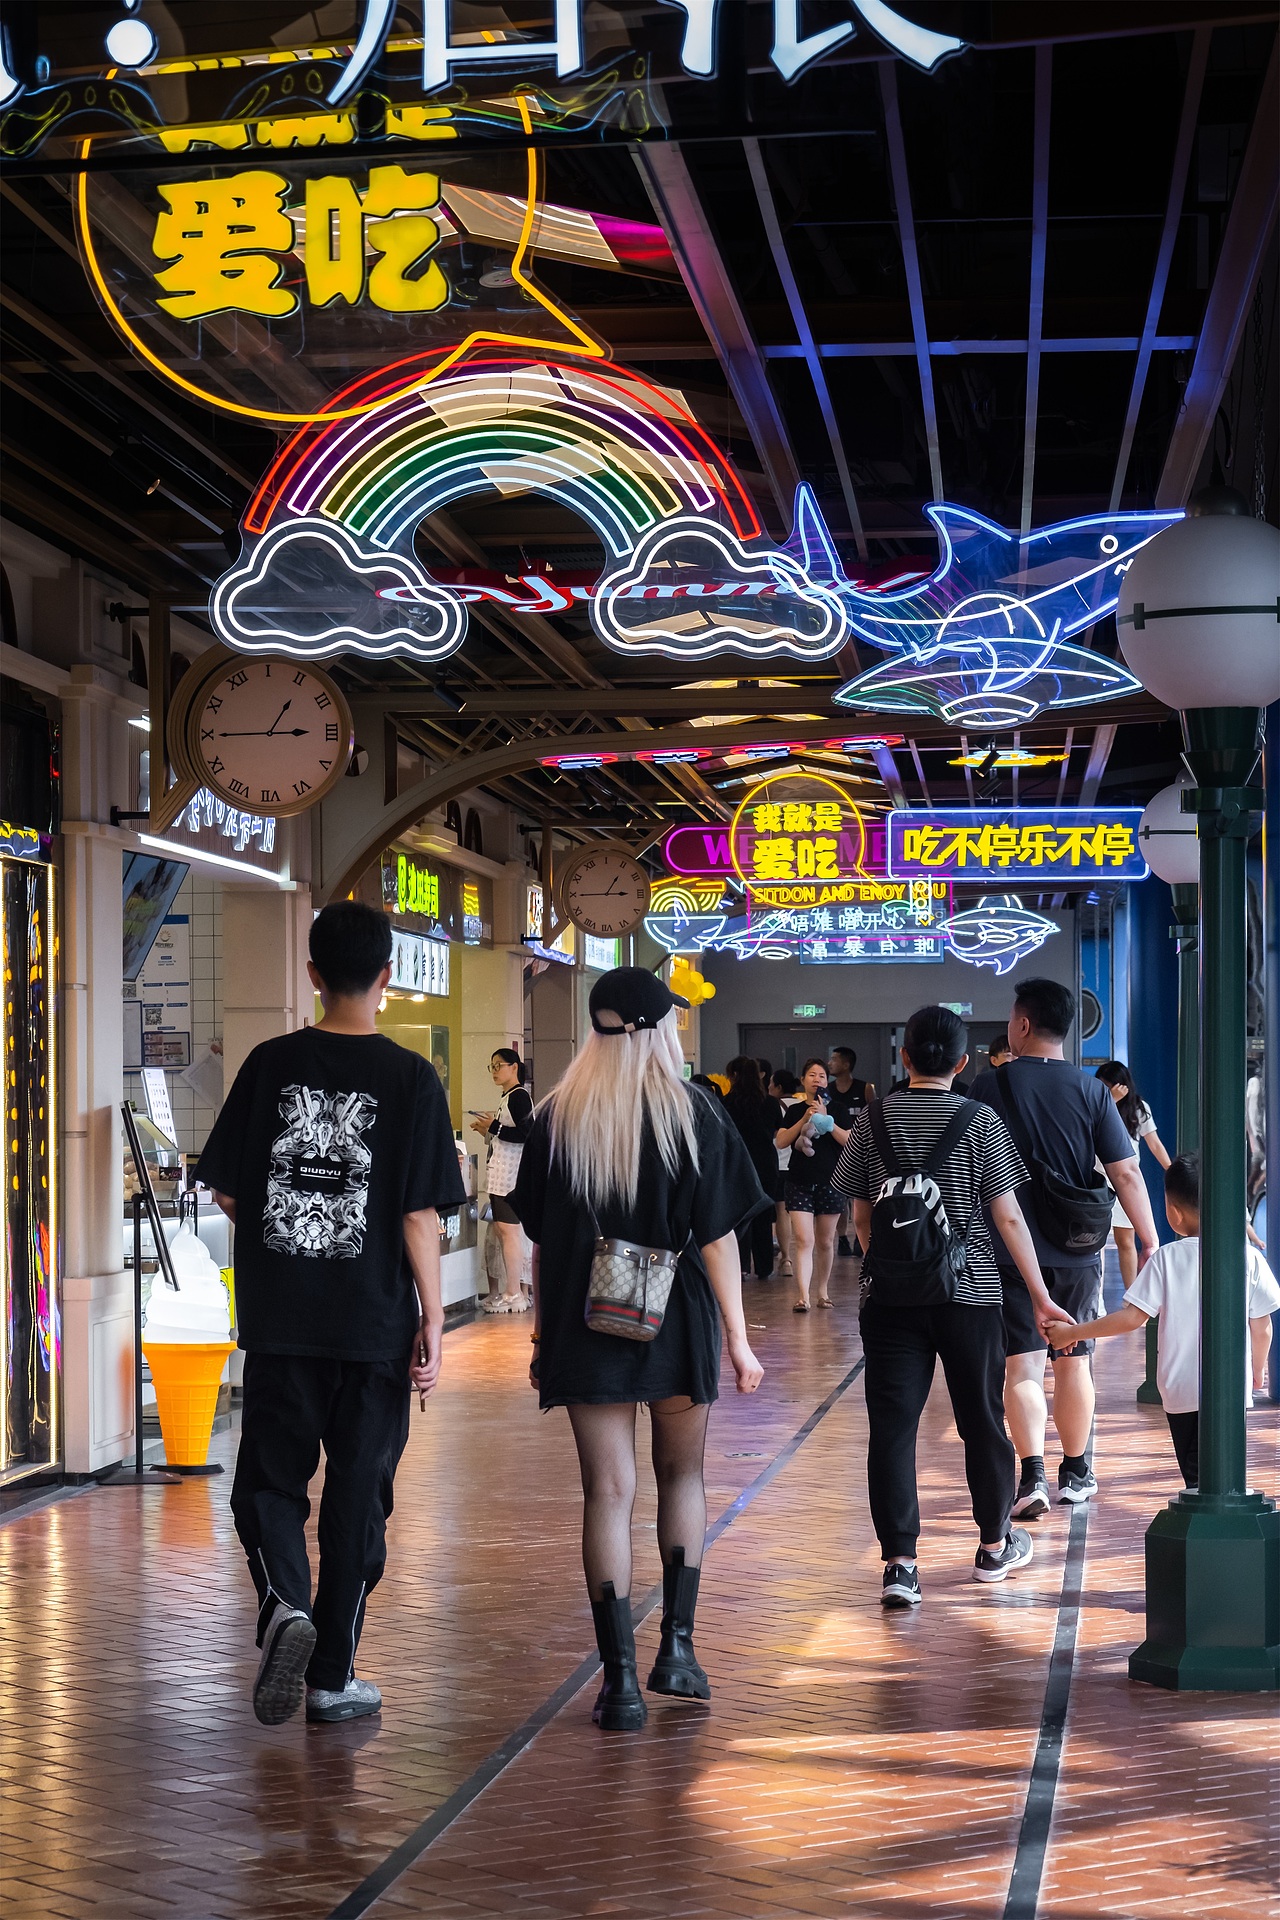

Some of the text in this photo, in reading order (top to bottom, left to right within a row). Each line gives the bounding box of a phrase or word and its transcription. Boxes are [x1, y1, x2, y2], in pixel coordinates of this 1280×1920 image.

[153, 164, 451, 320] 爱吃
[226, 670, 249, 691] XII
[292, 672, 307, 686] II
[206, 695, 223, 714] XI
[314, 692, 331, 710] III
[325, 723, 338, 742] IIII
[207, 756, 225, 775] IX
[228, 778, 250, 798] VIII
[260, 790, 281, 802] VII
[292, 780, 312, 797] VI
[753, 802, 843, 833] 我就是
[903, 823, 1135, 867] 吃不停乐不停
[753, 836, 840, 880] 爱吃
[754, 886, 816, 903] SITDON
[820, 884, 855, 902] AND
